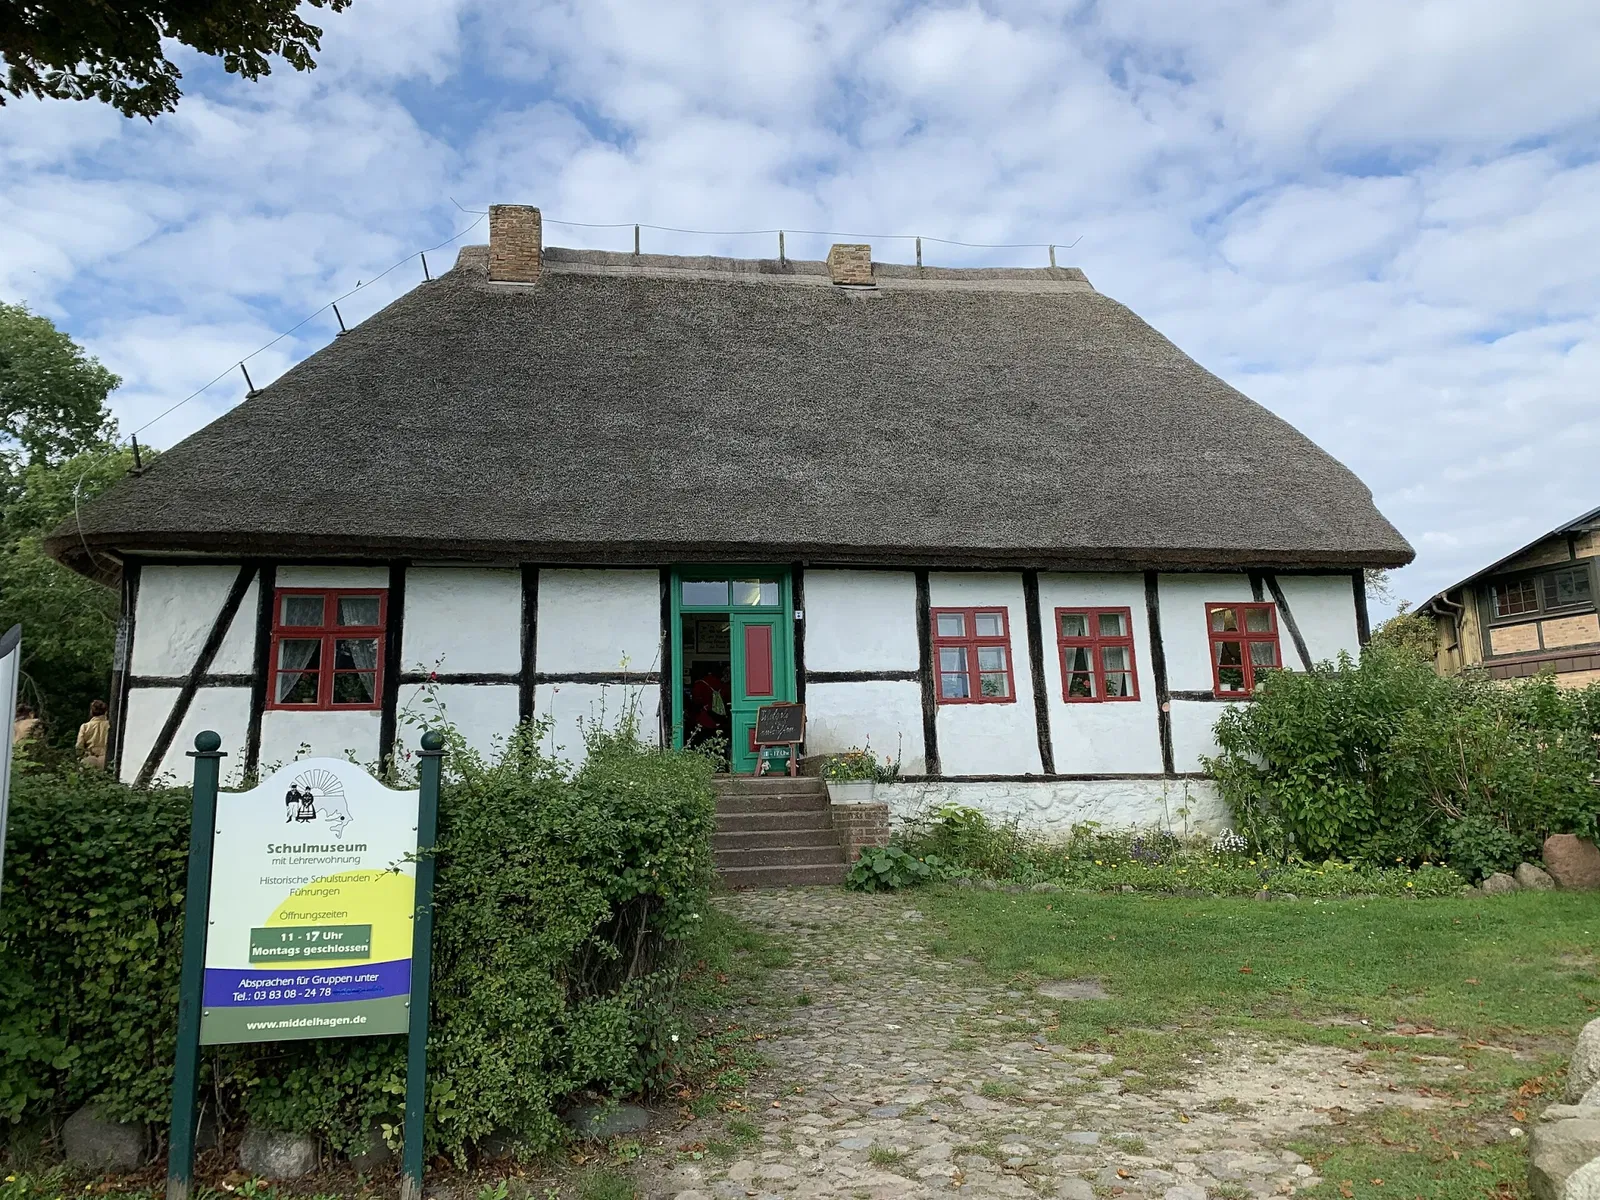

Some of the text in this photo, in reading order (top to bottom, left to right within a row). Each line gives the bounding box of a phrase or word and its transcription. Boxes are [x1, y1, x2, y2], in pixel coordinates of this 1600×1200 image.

[267, 843, 367, 854] Schulmuseum
[271, 855, 361, 866] mit Lehrerwohnung
[259, 873, 371, 885] Historische Schulstunden
[289, 887, 341, 898] Führungen
[279, 910, 348, 921] Öffnungszeiten
[280, 932, 294, 942] 11
[305, 931, 320, 942] 17
[322, 931, 343, 941] Uhr
[252, 943, 369, 957] Montags geschlossen
[238, 973, 380, 989] Absprachen für Gruppen unter
[232, 992, 252, 1002] Tel.:
[253, 990, 267, 1000] 03
[268, 990, 281, 1000] 83
[284, 989, 296, 999] 08
[304, 988, 317, 998] 24
[318, 988, 331, 997] 78
[247, 1015, 366, 1030] www.middelhagen.de
